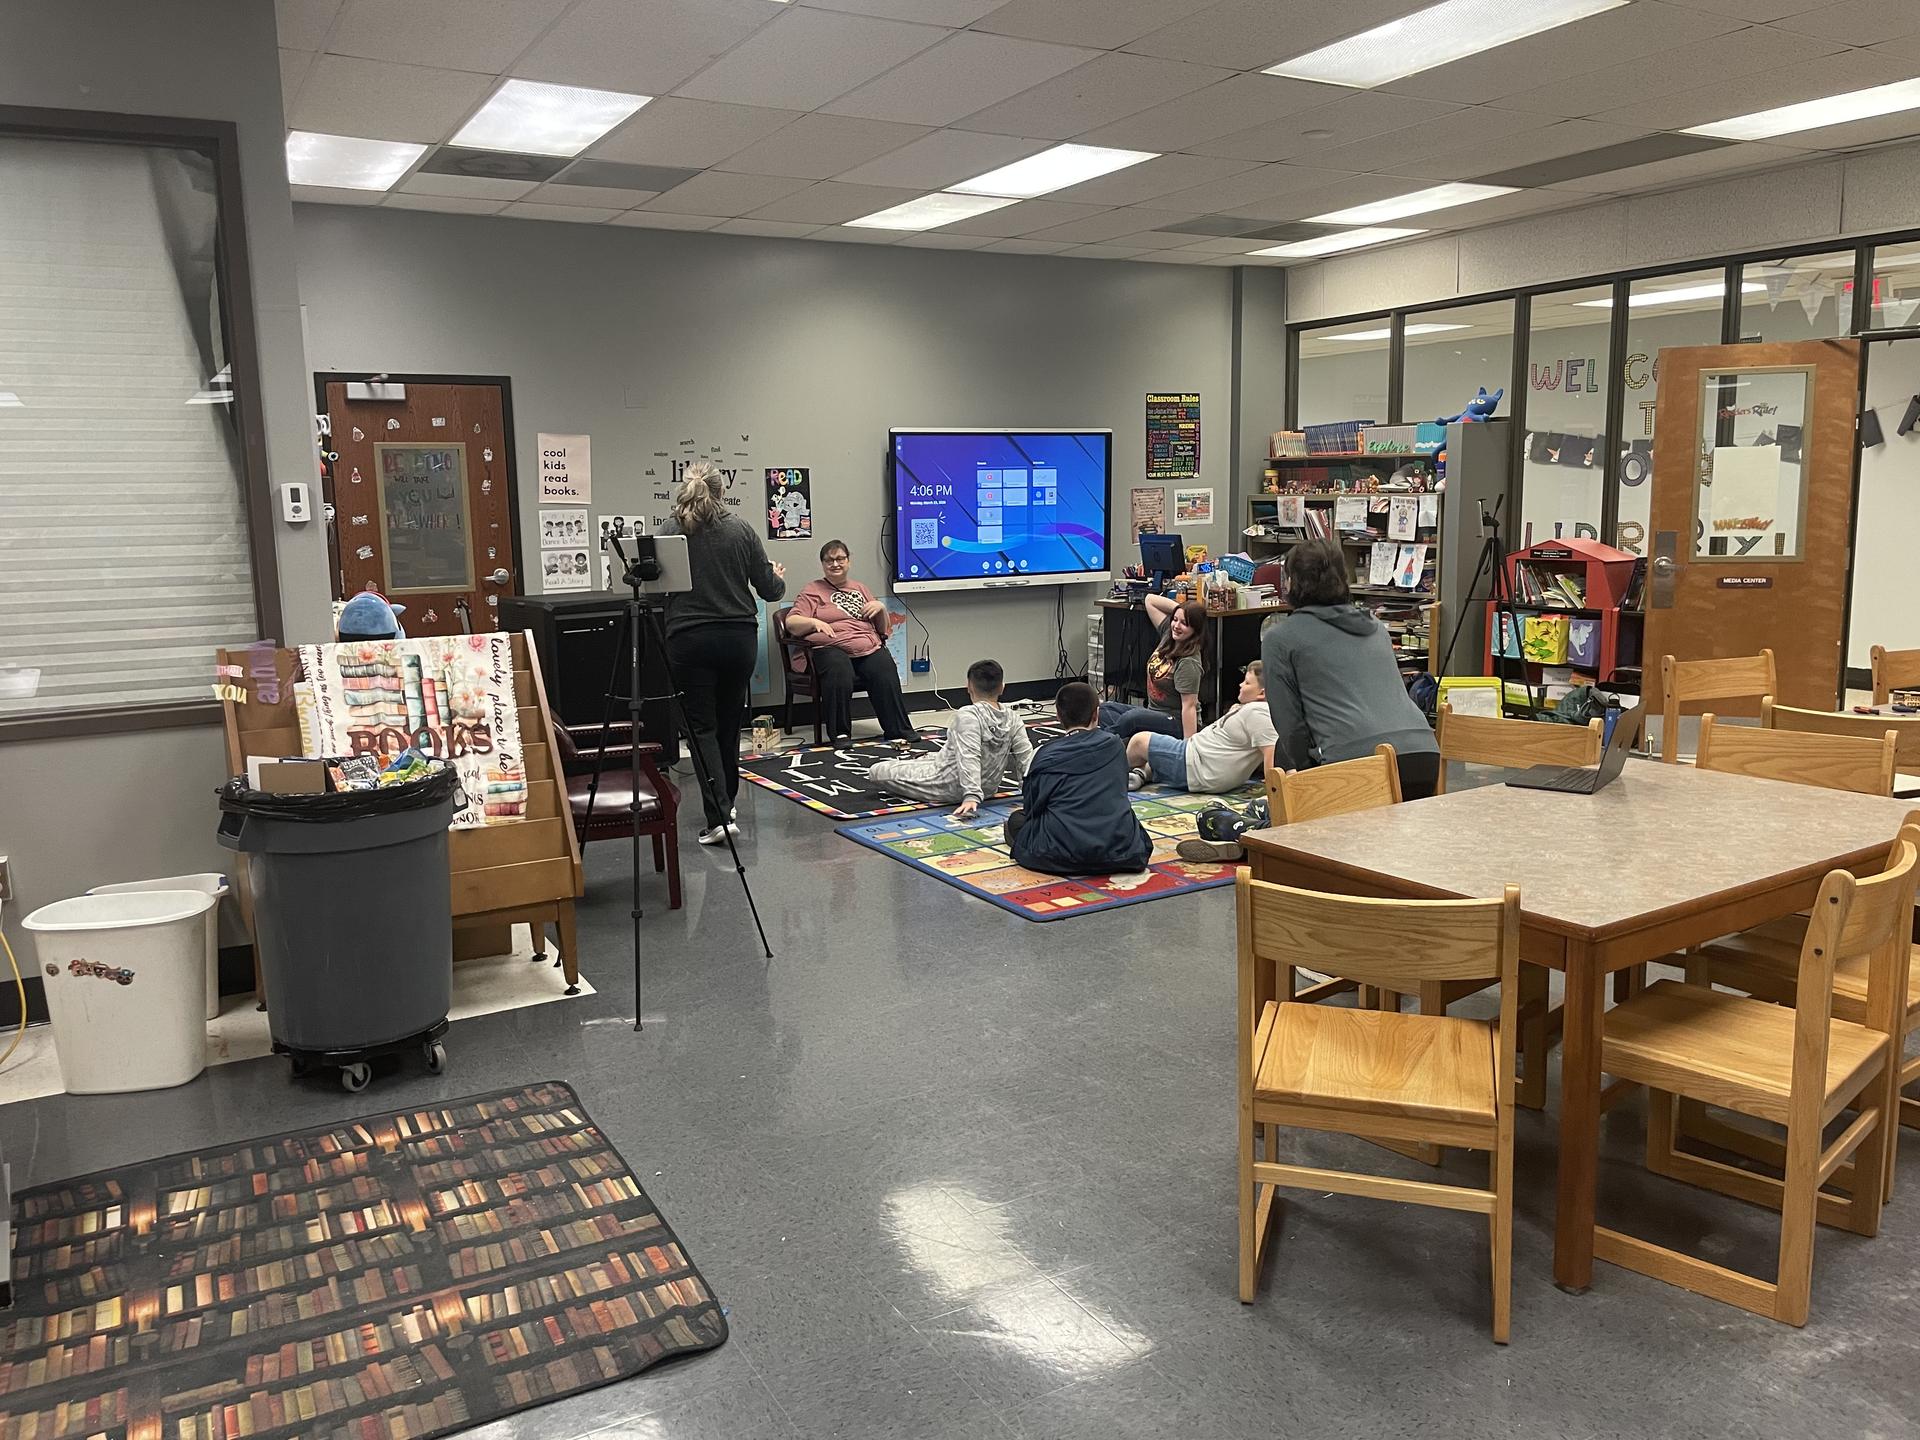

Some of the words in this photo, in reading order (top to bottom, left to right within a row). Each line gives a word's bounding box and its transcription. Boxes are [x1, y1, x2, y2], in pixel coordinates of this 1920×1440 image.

[543, 449, 566, 458] cool
[543, 460, 566, 470] kids
[544, 474, 568, 483] read
[544, 486, 579, 496] books.
[910, 484, 933, 496] 4:06
[935, 484, 952, 496] PM
[654, 491, 670, 500] read
[490, 638, 506, 687] lovely
[487, 693, 506, 735] place
[347, 721, 493, 759] BOOKS
